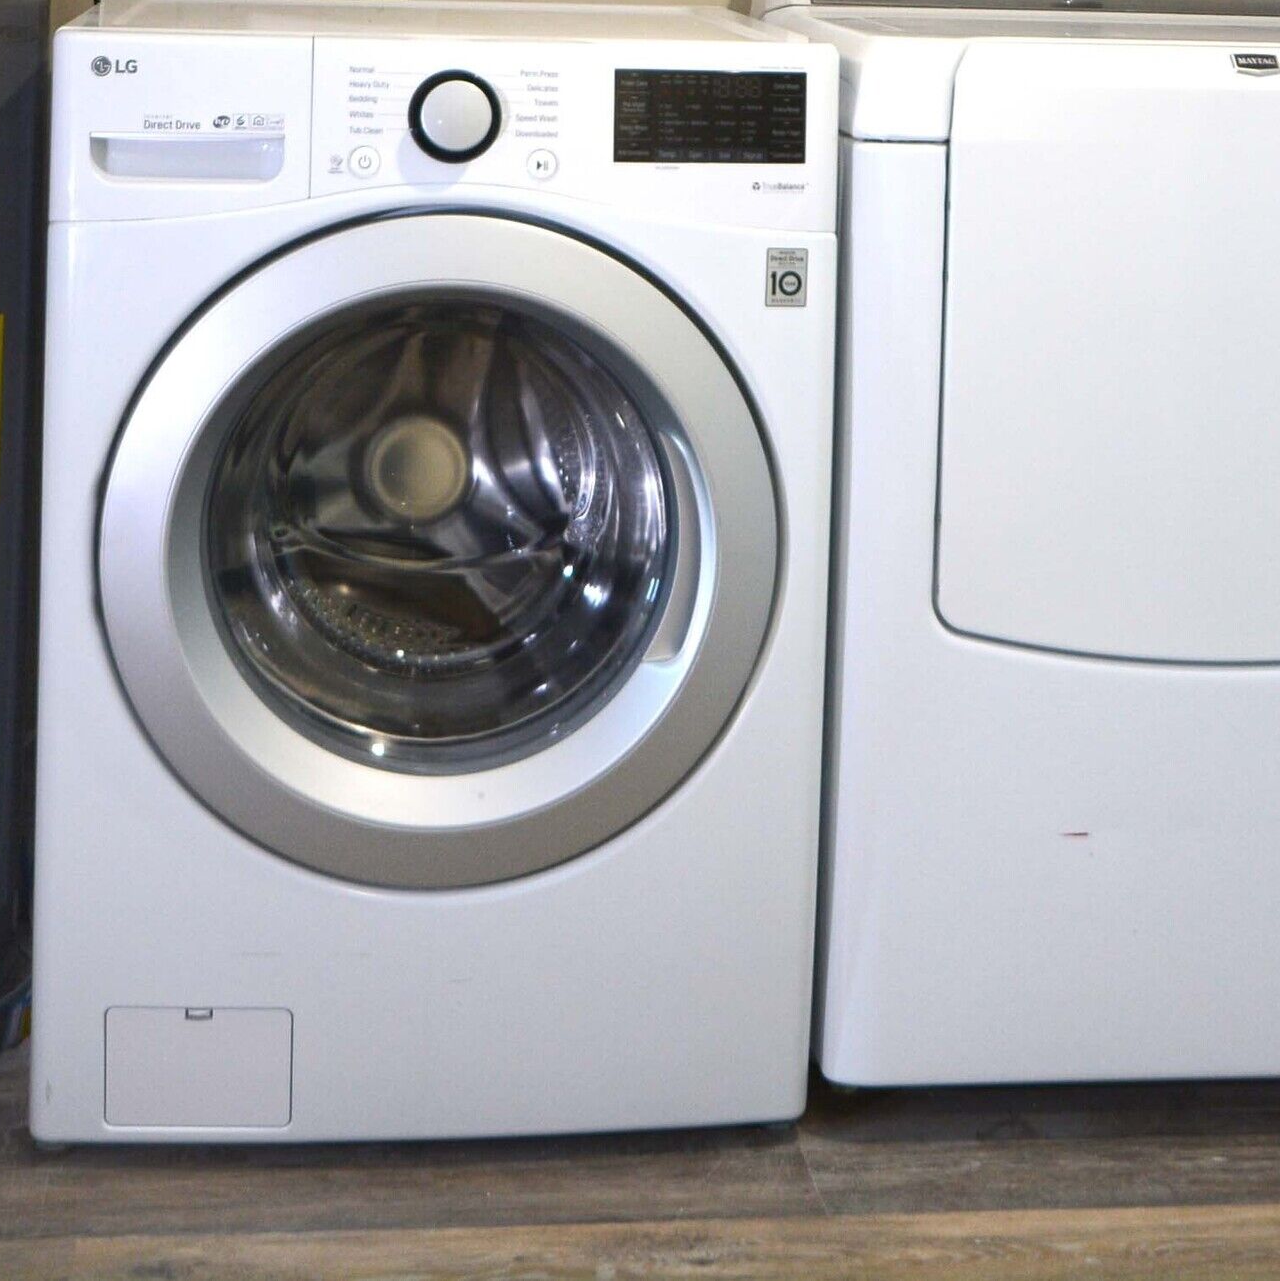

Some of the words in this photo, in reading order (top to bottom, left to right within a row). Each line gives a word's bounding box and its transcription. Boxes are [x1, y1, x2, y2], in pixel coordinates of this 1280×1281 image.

[115, 59, 138, 74] LG
[144, 120, 173, 130] Direct
[175, 120, 201, 130] Drive
[771, 270, 802, 296] 10
